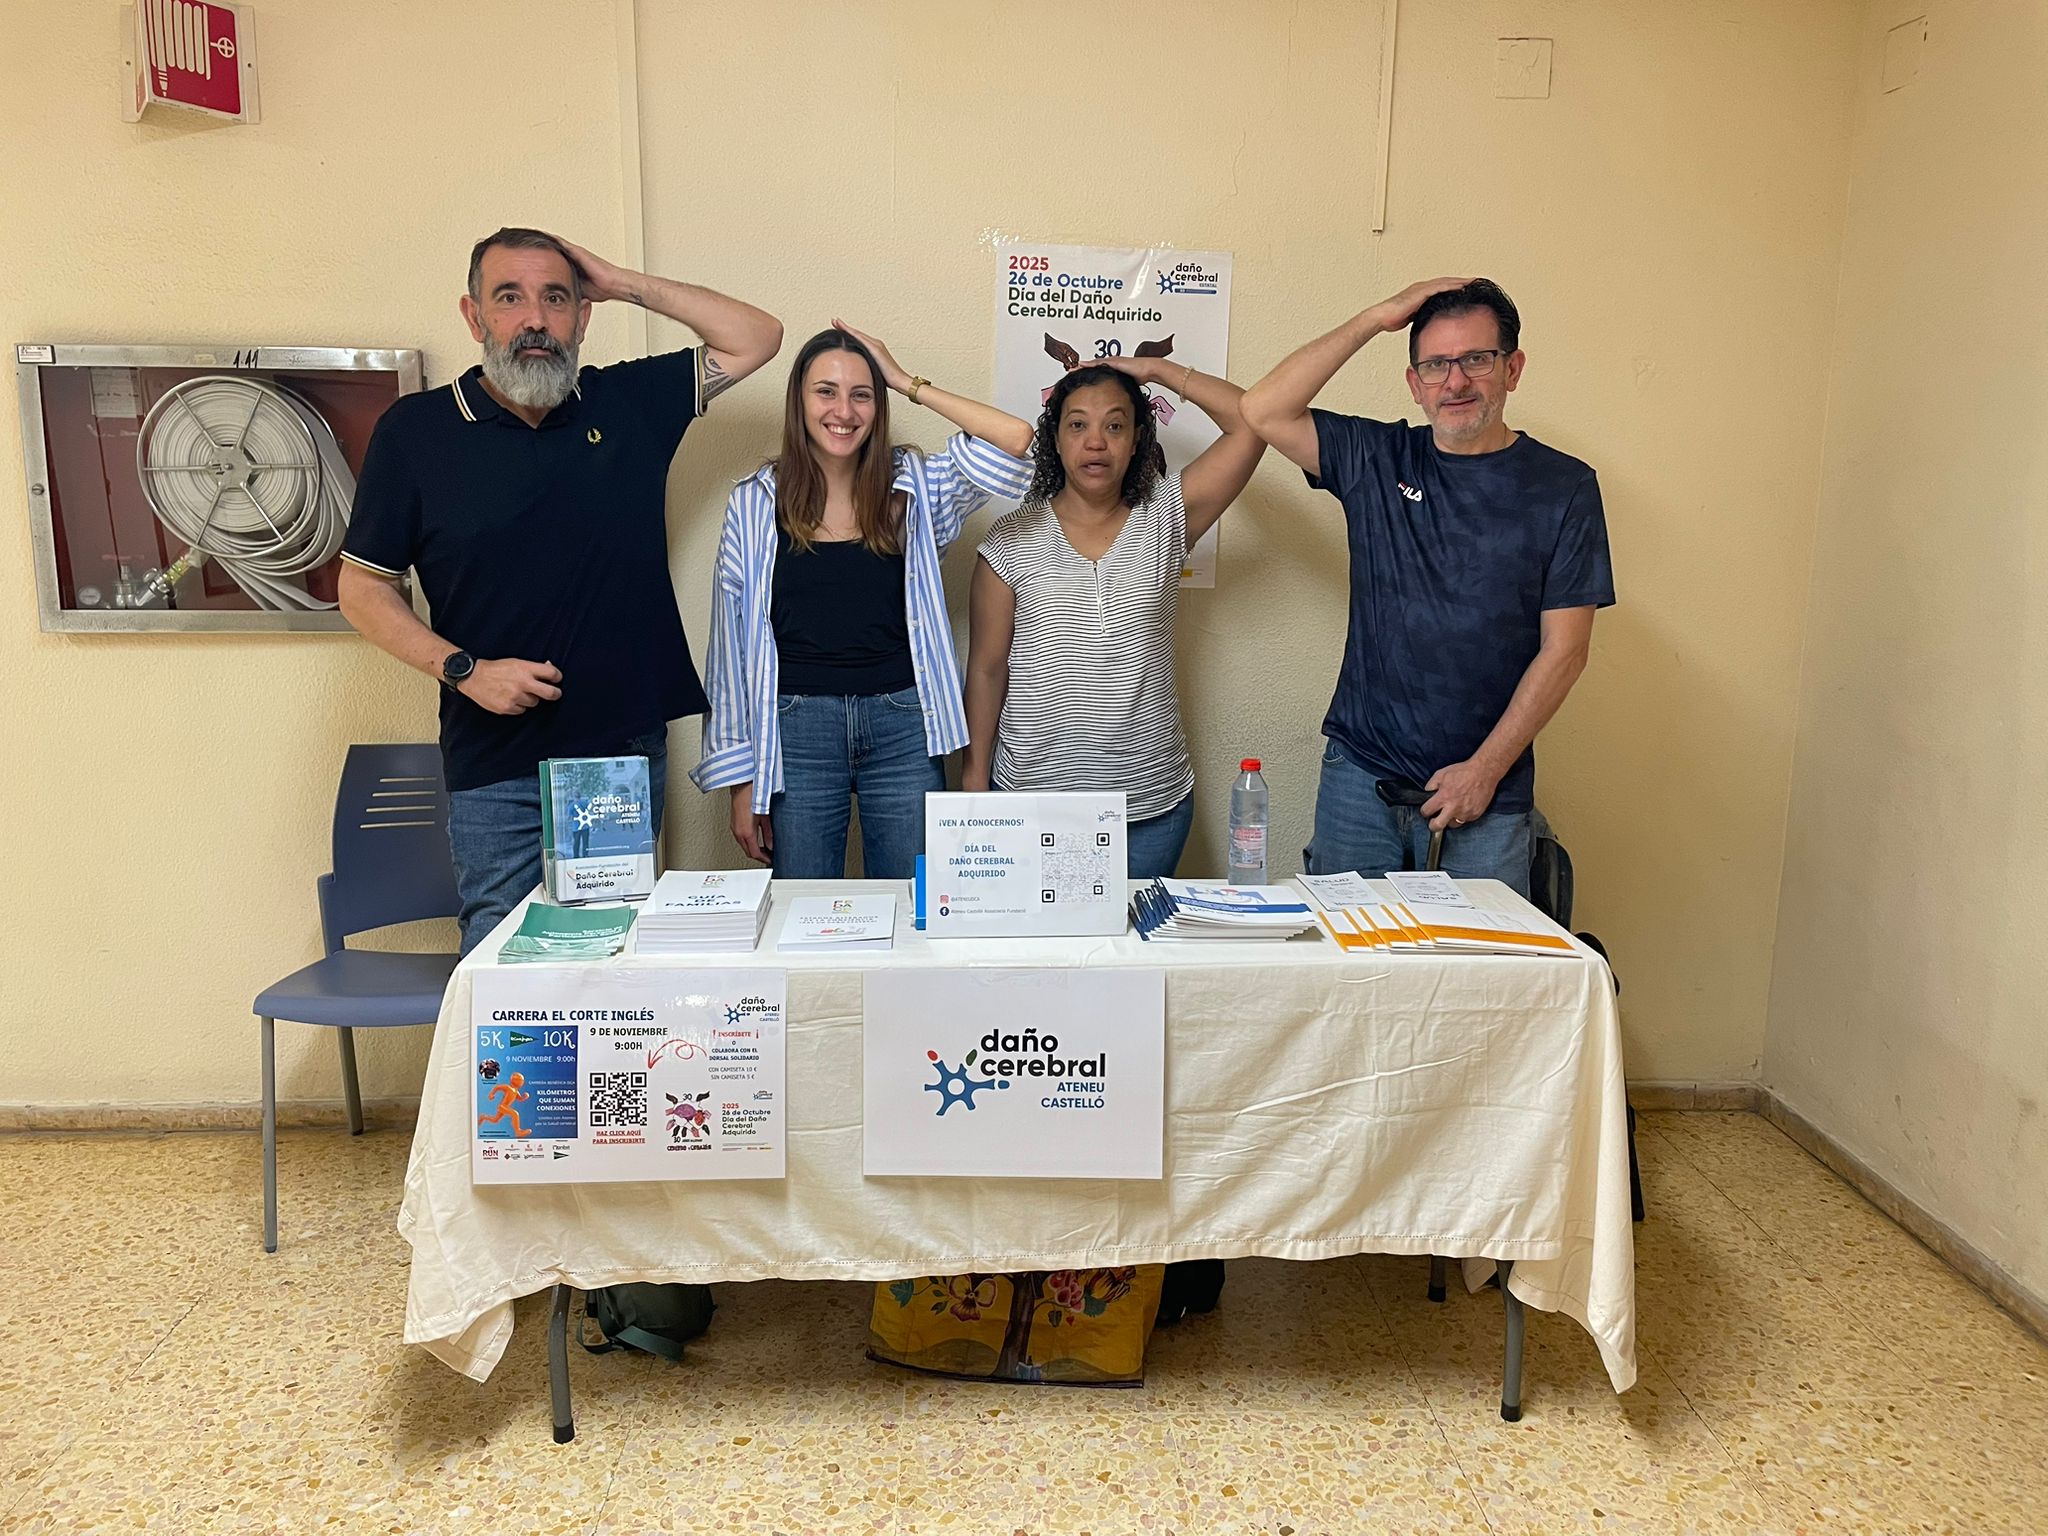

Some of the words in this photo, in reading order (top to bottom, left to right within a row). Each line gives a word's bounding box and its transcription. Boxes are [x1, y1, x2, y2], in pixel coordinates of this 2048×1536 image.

[1009, 255, 1049, 271] 2025
[1175, 262, 1203, 273] daño
[1008, 271, 1028, 286] 26
[1032, 273, 1053, 287] de
[1057, 273, 1124, 290] Octubre
[1175, 272, 1219, 283] cerebral
[1008, 287, 1035, 302] Día
[1040, 288, 1065, 303] del
[1070, 290, 1113, 305] Daño
[1008, 303, 1079, 319] Cerebral
[1083, 306, 1162, 324] Adquirido
[1094, 338, 1122, 359] 30
[592, 794, 622, 805] daño
[592, 801, 640, 813] cerebral
[939, 819, 957, 827] ¡VEN
[959, 819, 965, 827] A
[967, 818, 1024, 827] CONOCERNOS!
[964, 842, 980, 853] DÍA
[982, 845, 997, 853] DEL
[949, 855, 972, 865] DAÑO
[974, 857, 1015, 865] CEREBRAL
[576, 871, 597, 880] Daño
[958, 869, 1006, 880] ADQUIRIDO
[576, 880, 615, 890] Adquirido
[741, 996, 766, 1005] daño
[741, 1004, 780, 1012] cerebral
[492, 1010, 548, 1021] CARRERA
[552, 1010, 566, 1021] EL
[569, 1010, 608, 1021] CORTE
[611, 1007, 654, 1021] INGLÉS
[590, 1028, 596, 1036] 9
[600, 1028, 611, 1036] DE
[613, 1027, 668, 1036] NOVIEMBRE
[480, 1031, 505, 1049] 5K
[543, 1031, 576, 1049] 10K
[980, 1028, 1059, 1053] daño
[614, 1042, 642, 1050] 9:00H
[980, 1053, 1106, 1078] cerebral
[1057, 1082, 1105, 1093] ATENEU
[1041, 1095, 1105, 1109] CASTELLÓ
[627, 1129, 641, 1137] AQUÍ
